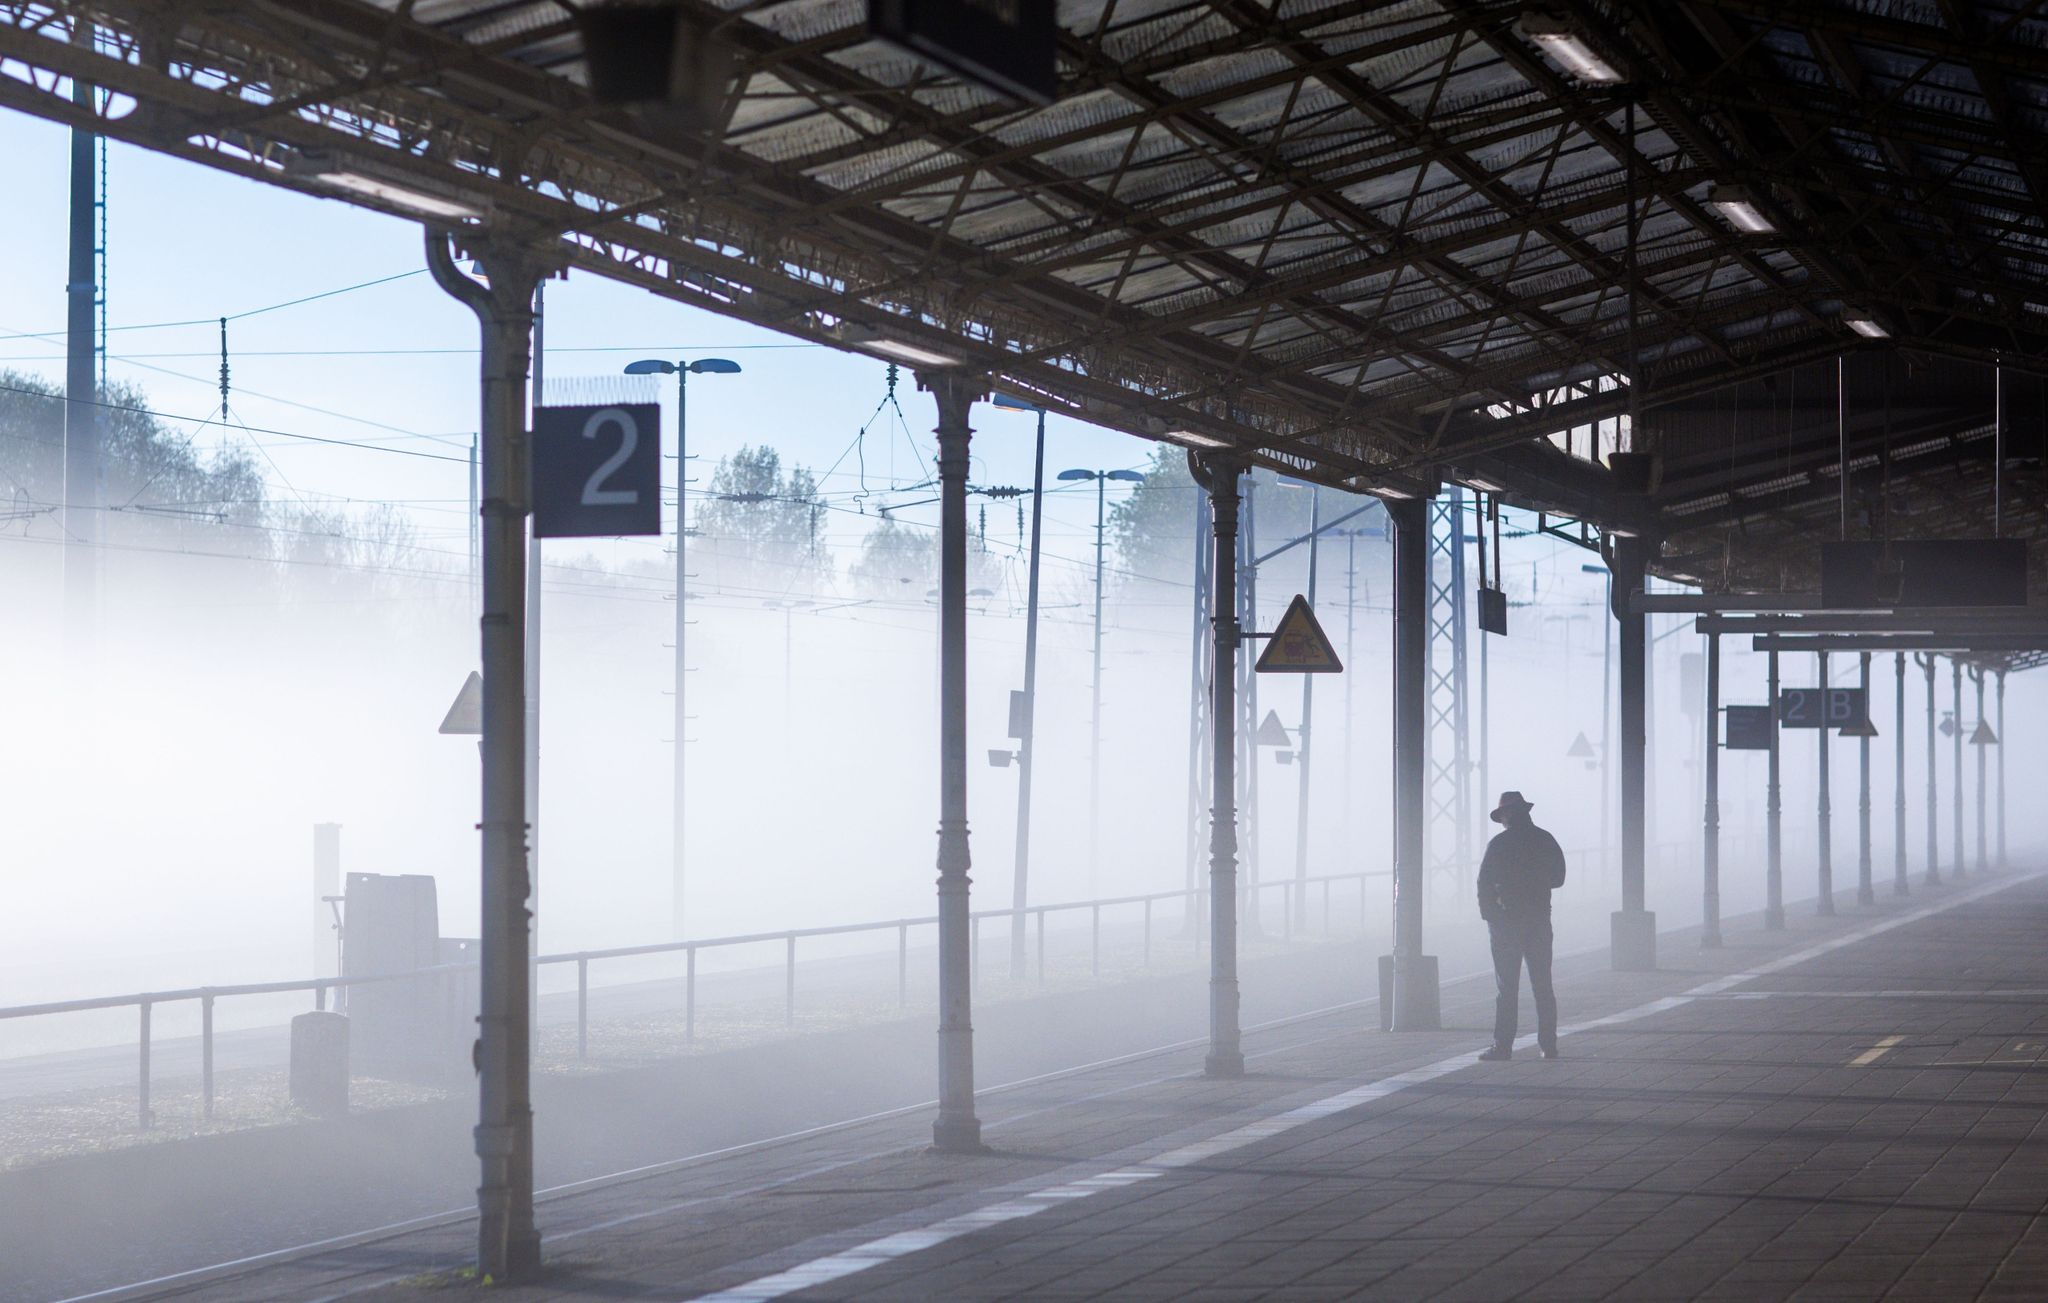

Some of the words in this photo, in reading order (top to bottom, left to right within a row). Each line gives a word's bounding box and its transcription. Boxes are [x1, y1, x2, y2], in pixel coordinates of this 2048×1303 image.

[581, 408, 639, 506] 2
[1787, 690, 1806, 720] 2
[1829, 690, 1852, 720] B
